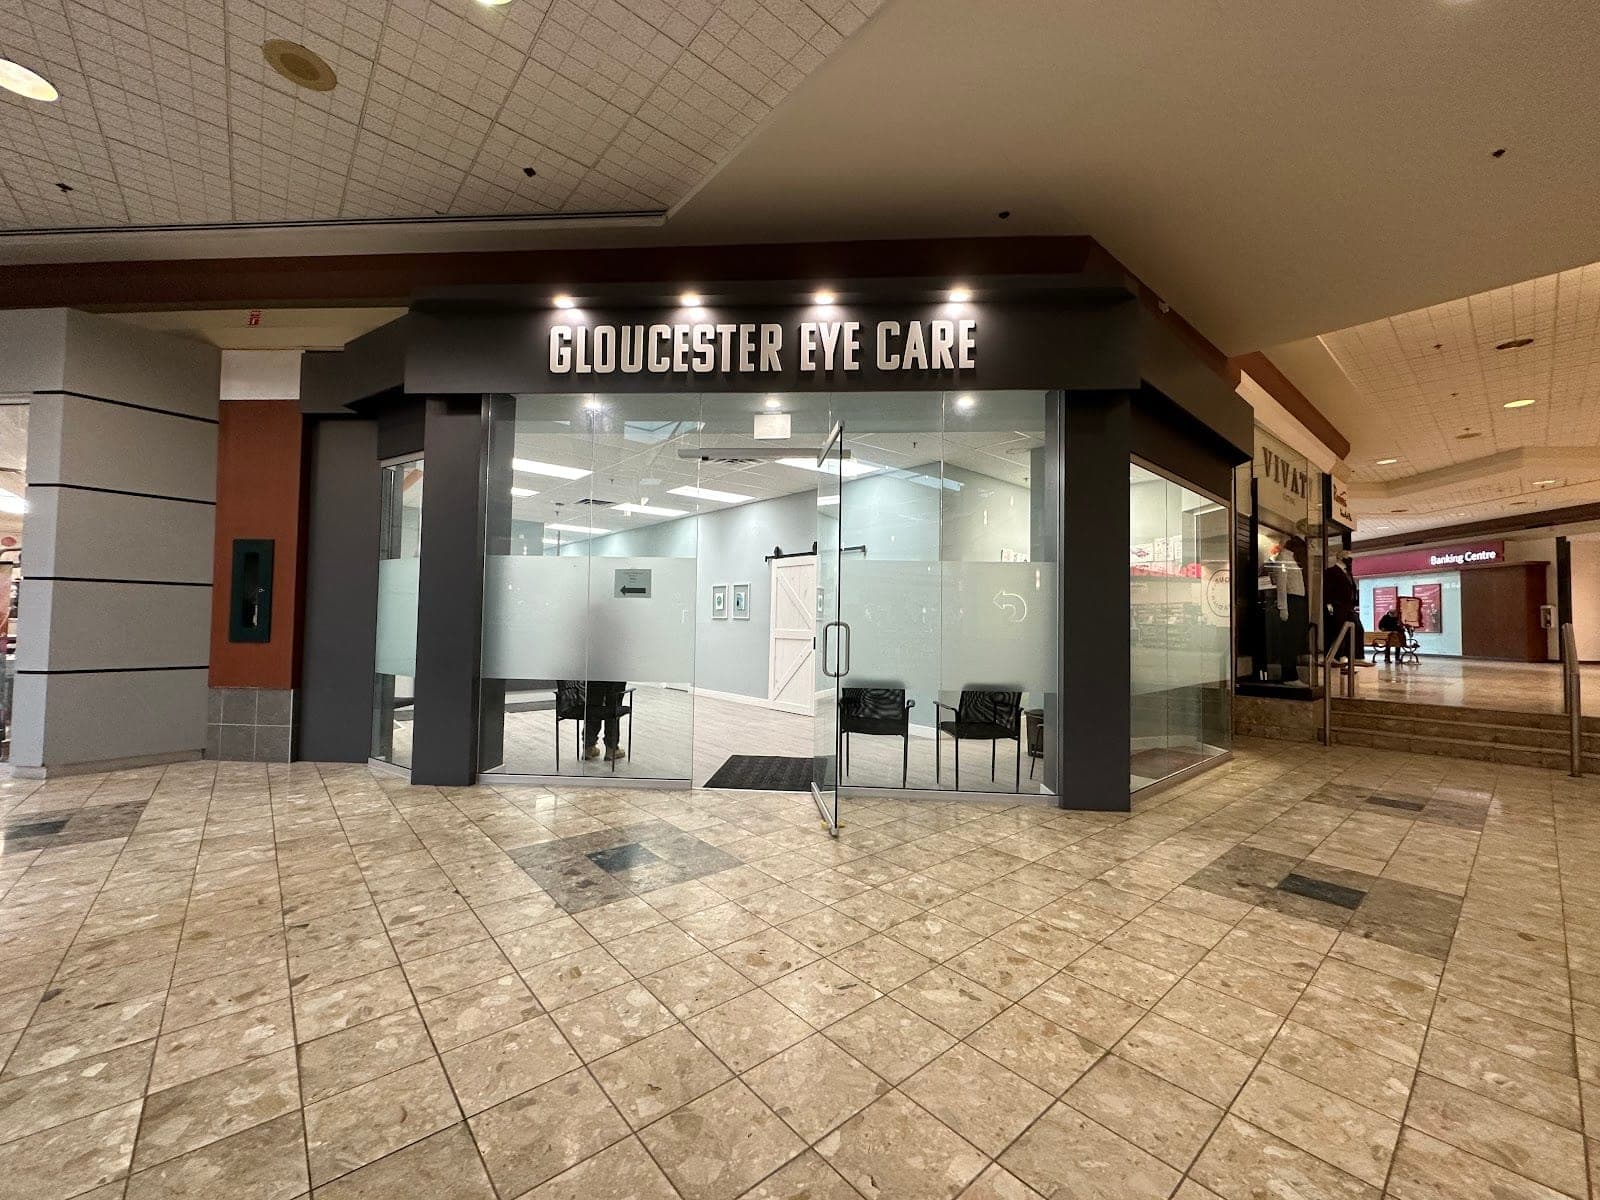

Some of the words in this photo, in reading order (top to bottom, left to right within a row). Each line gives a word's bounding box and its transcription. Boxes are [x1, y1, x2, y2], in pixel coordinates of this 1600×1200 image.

[548, 322, 783, 374] GLOUCESTER
[799, 320, 860, 373] EYE
[876, 318, 976, 371] CARE
[1262, 446, 1307, 499] VIVAT
[1430, 553, 1464, 566] Banking
[1464, 550, 1496, 562] Centre
